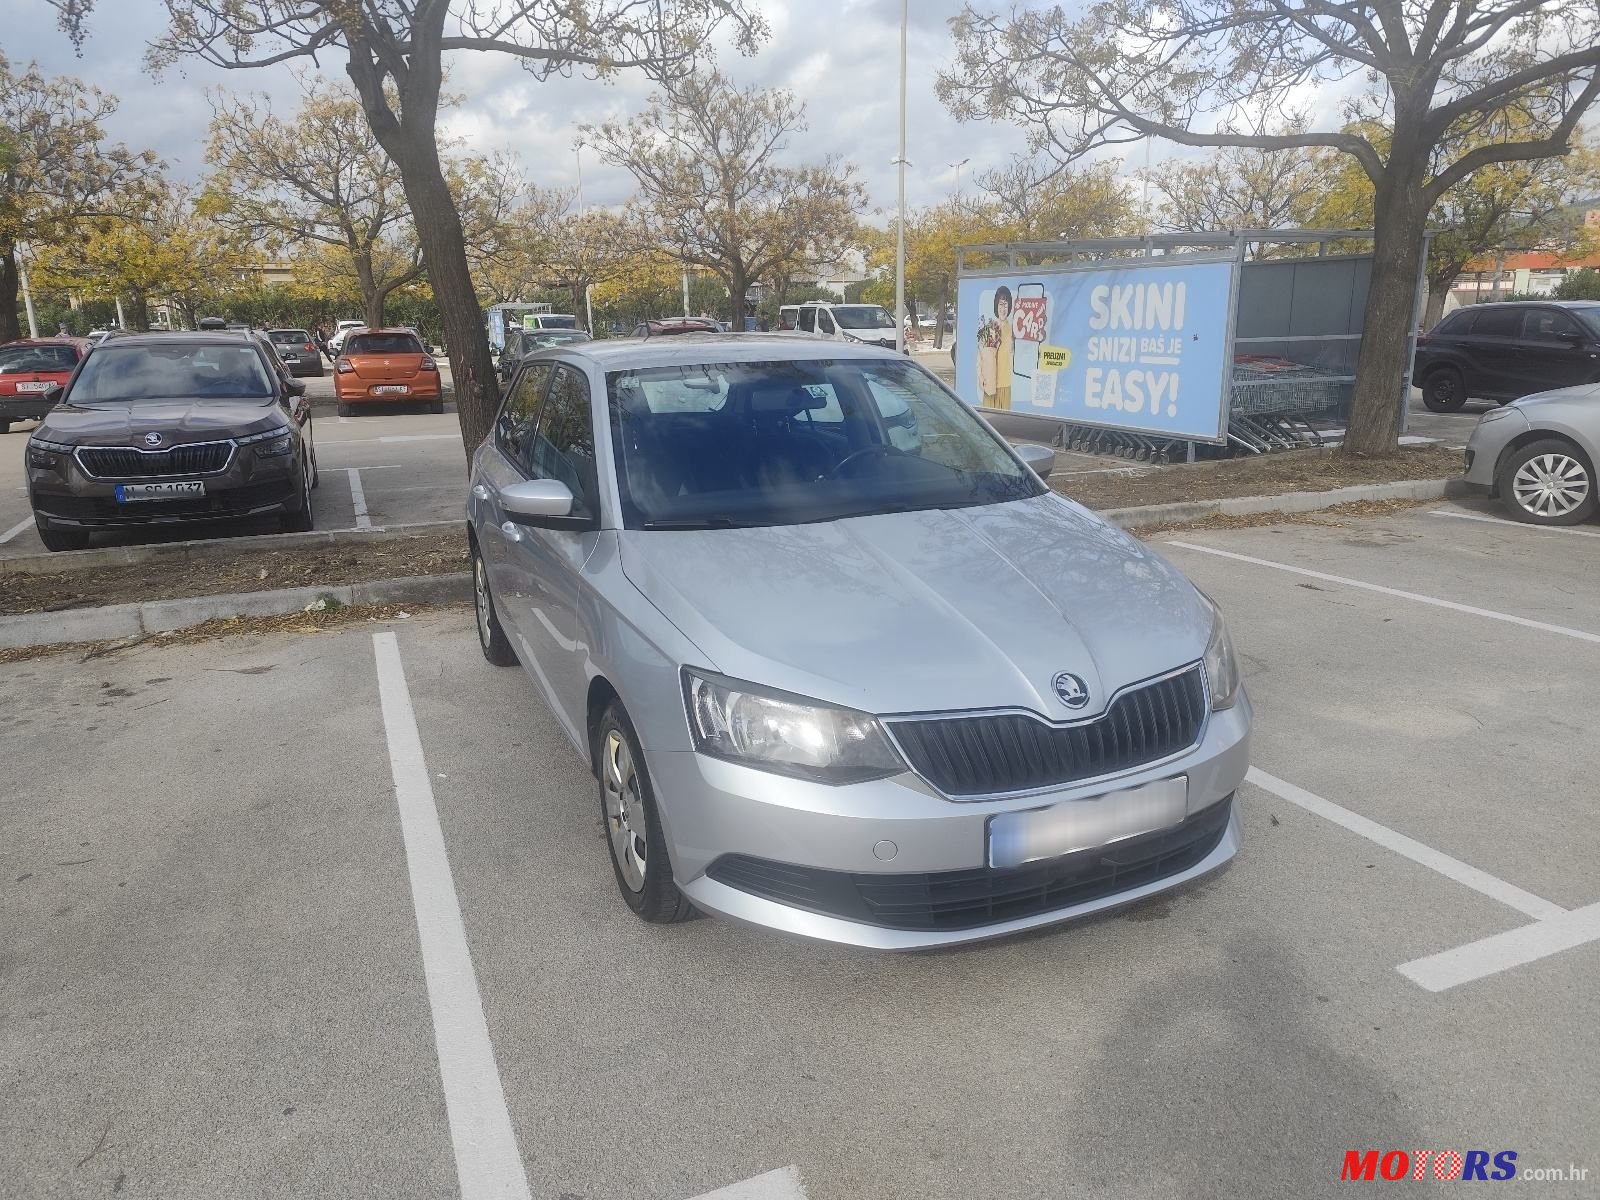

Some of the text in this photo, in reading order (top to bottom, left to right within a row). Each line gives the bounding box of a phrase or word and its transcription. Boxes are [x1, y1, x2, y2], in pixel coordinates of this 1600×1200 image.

[1089, 282, 1186, 331] SKINI
[1087, 333, 1182, 363] SNIZI BAŠ JE
[1085, 367, 1179, 418] EASY!
